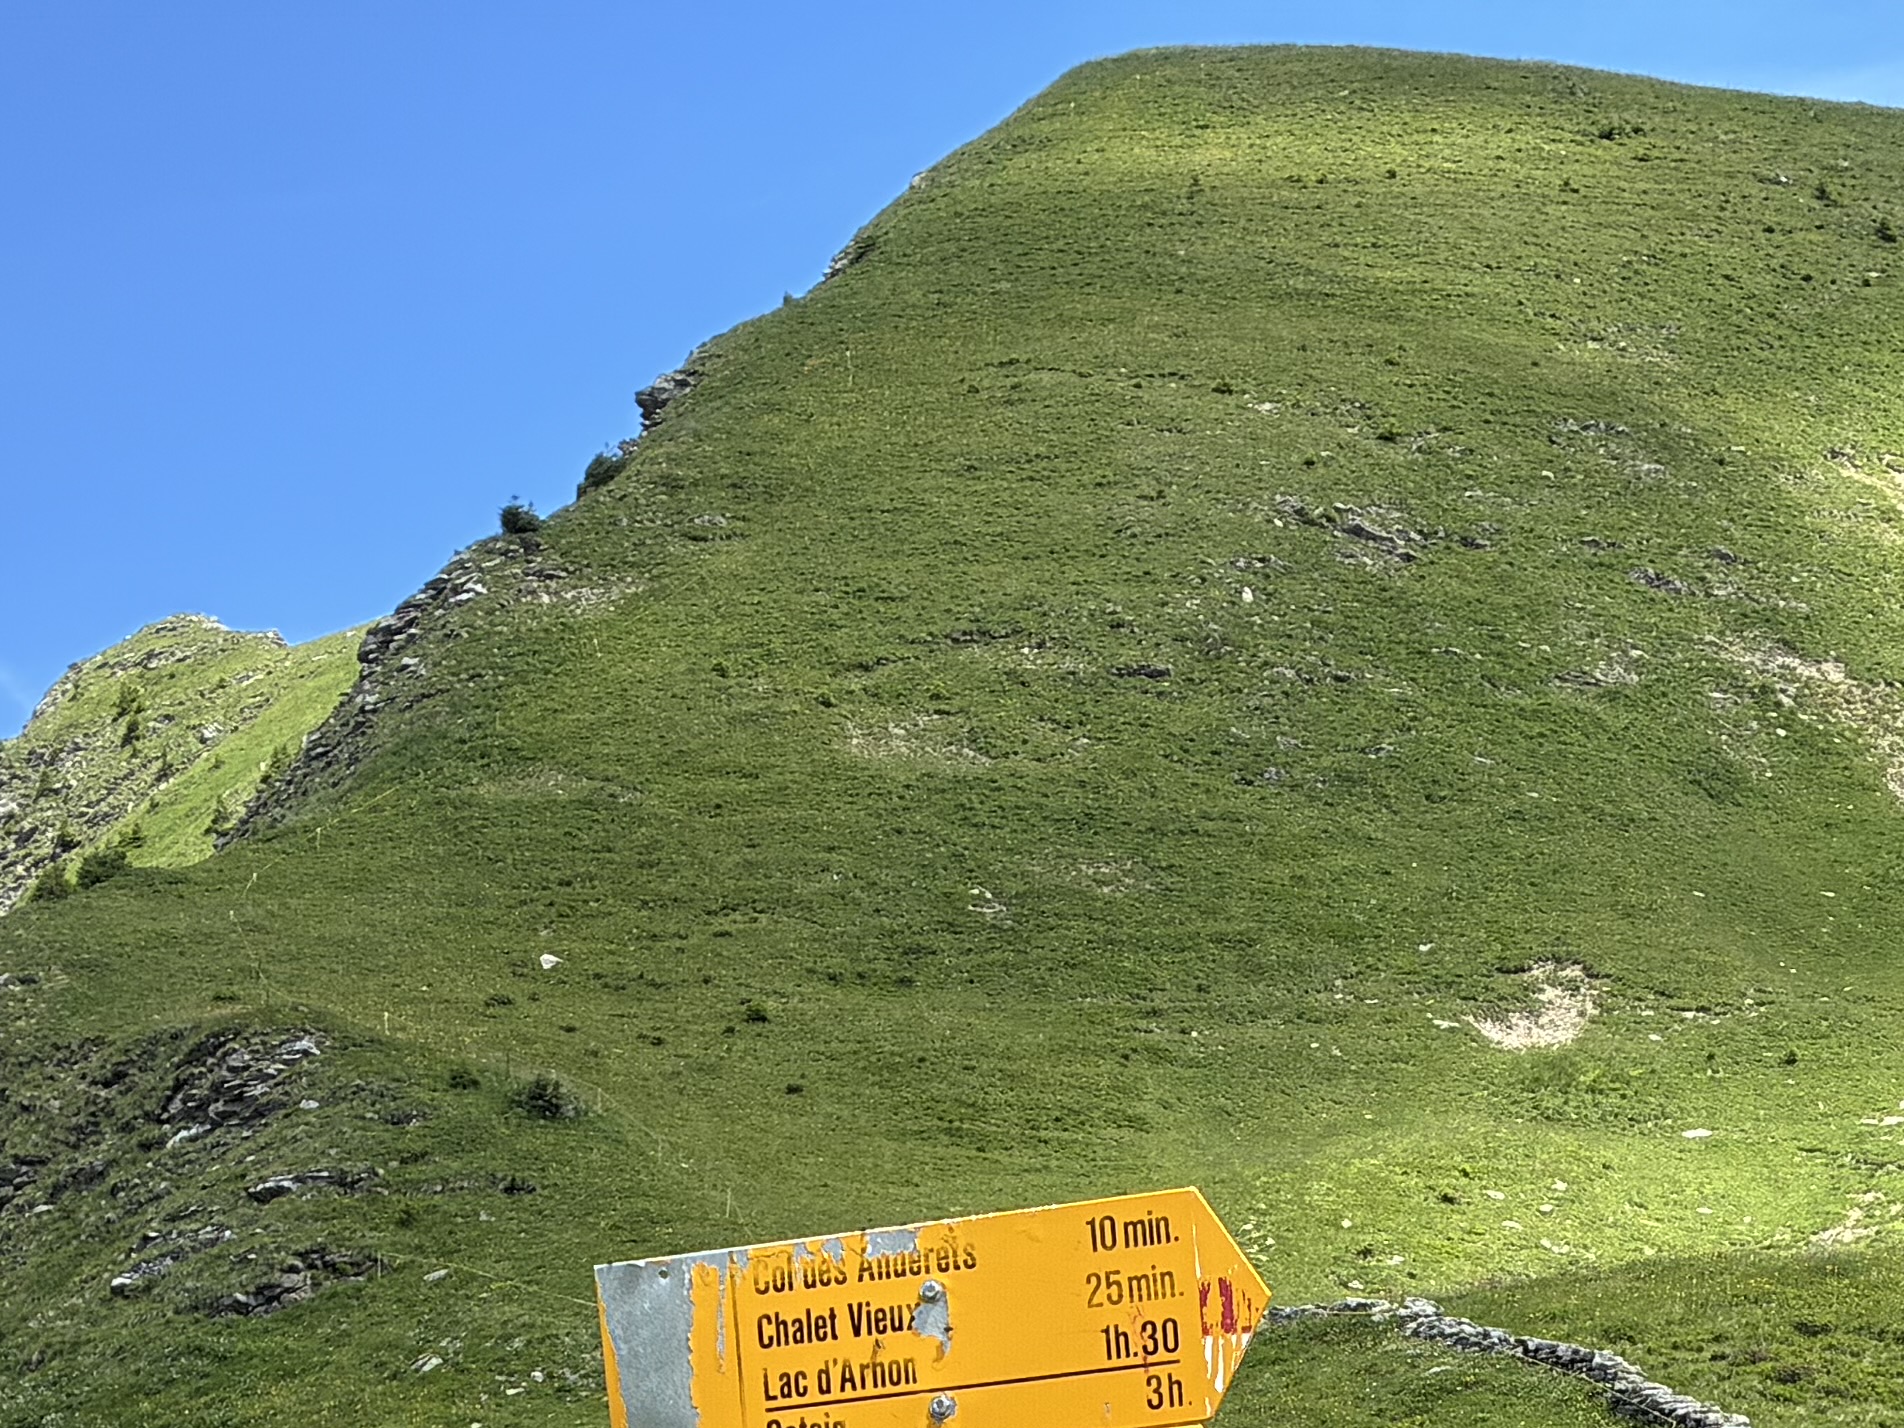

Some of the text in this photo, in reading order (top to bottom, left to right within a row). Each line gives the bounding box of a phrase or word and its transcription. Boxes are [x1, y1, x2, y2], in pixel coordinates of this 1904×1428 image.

[757, 1307, 839, 1349] Chalet
[763, 1367, 809, 1401] Lac
[817, 1357, 918, 1395] d'Arnon
